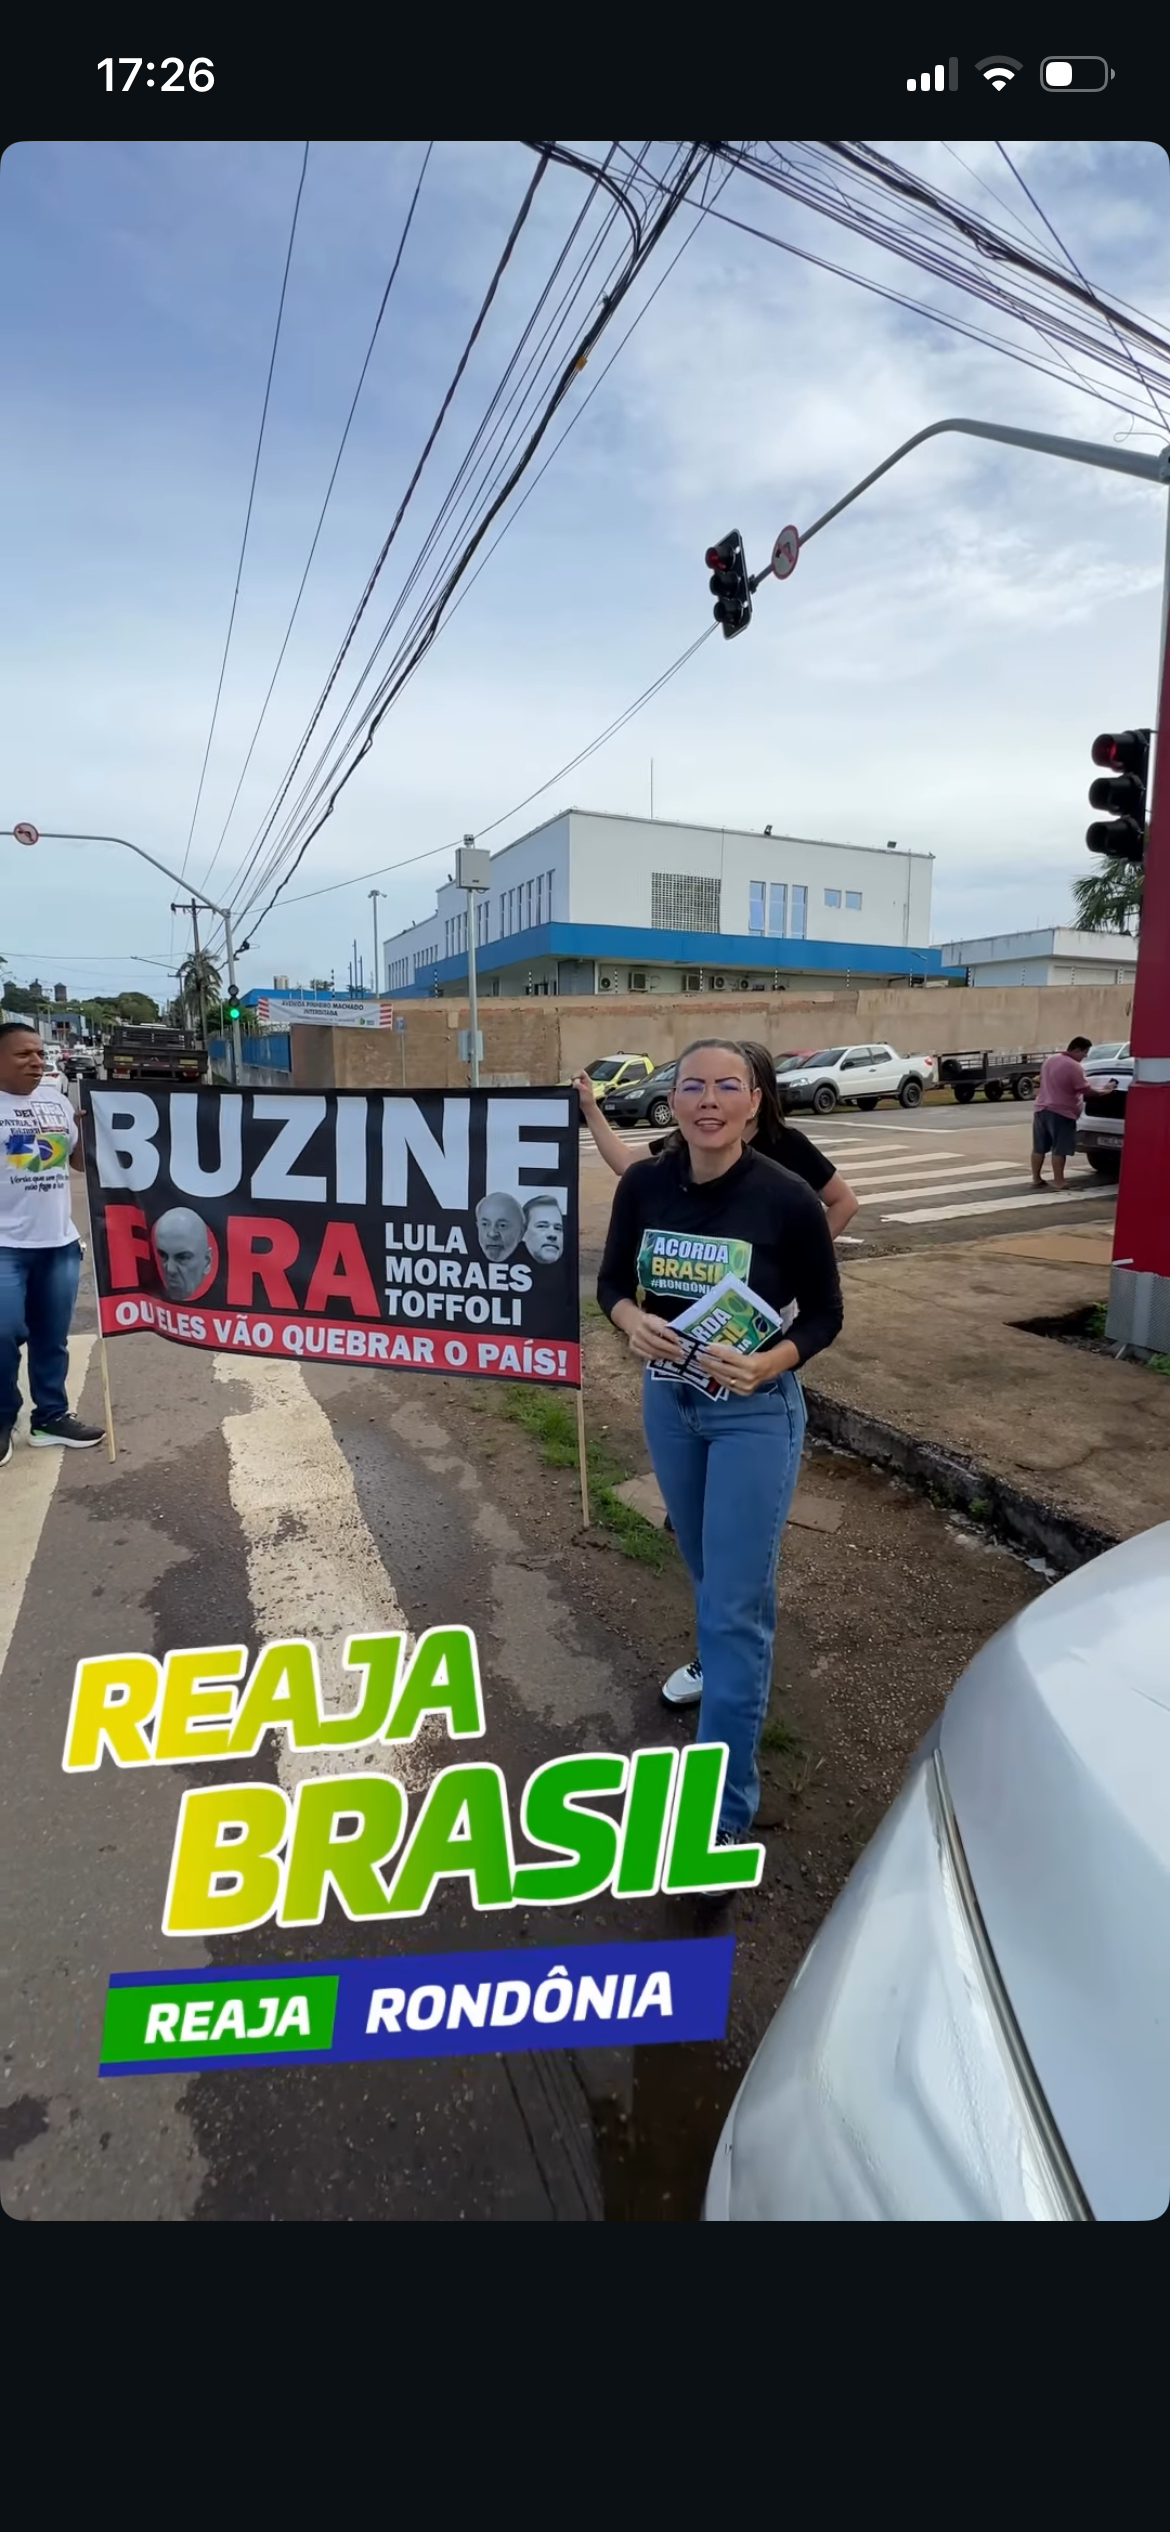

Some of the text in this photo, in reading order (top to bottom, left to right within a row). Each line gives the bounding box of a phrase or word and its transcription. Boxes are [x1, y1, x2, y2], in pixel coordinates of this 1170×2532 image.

[332, 1003, 364, 1011] MACHADO
[90, 1091, 569, 1215] BUZINE
[385, 1222, 468, 1254] LULA
[653, 1236, 729, 1264] ACORDA
[386, 1256, 533, 1292] MORAES
[385, 1288, 522, 1326] TOFFOLI
[115, 1301, 567, 1377] OU ELES VÃO QUEBRAR O PAÍS!
